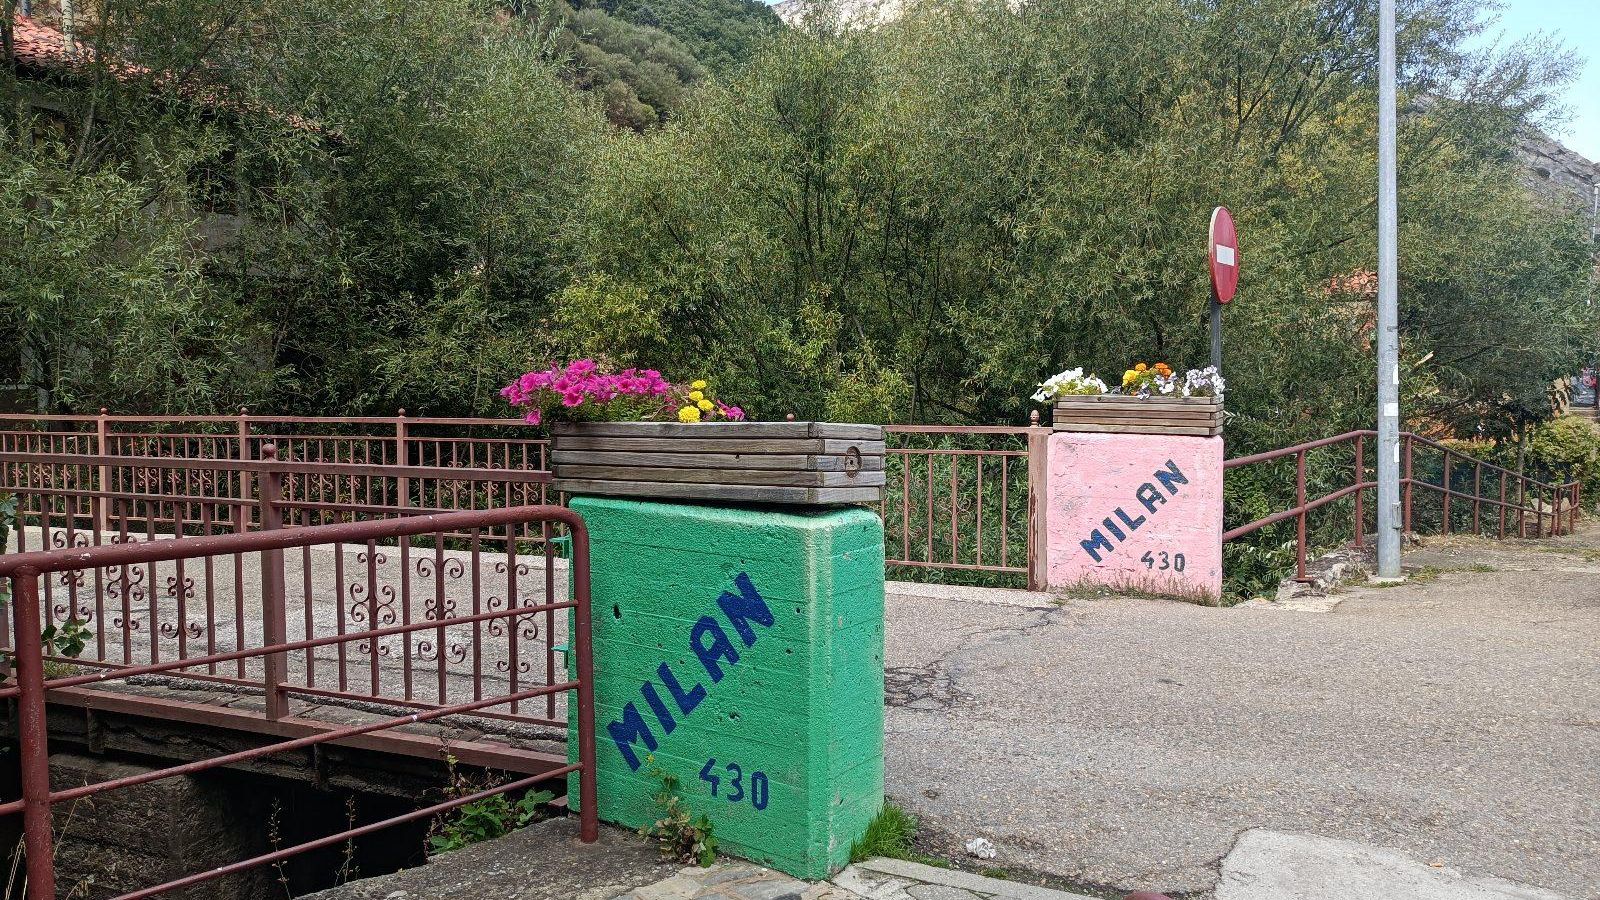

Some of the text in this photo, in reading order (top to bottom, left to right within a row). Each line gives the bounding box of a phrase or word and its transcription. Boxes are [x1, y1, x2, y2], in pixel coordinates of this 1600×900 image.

[1079, 459, 1189, 563] MILAN
[1140, 550, 1186, 572] 430
[606, 571, 775, 773] MILAN
[699, 758, 770, 811] 430
